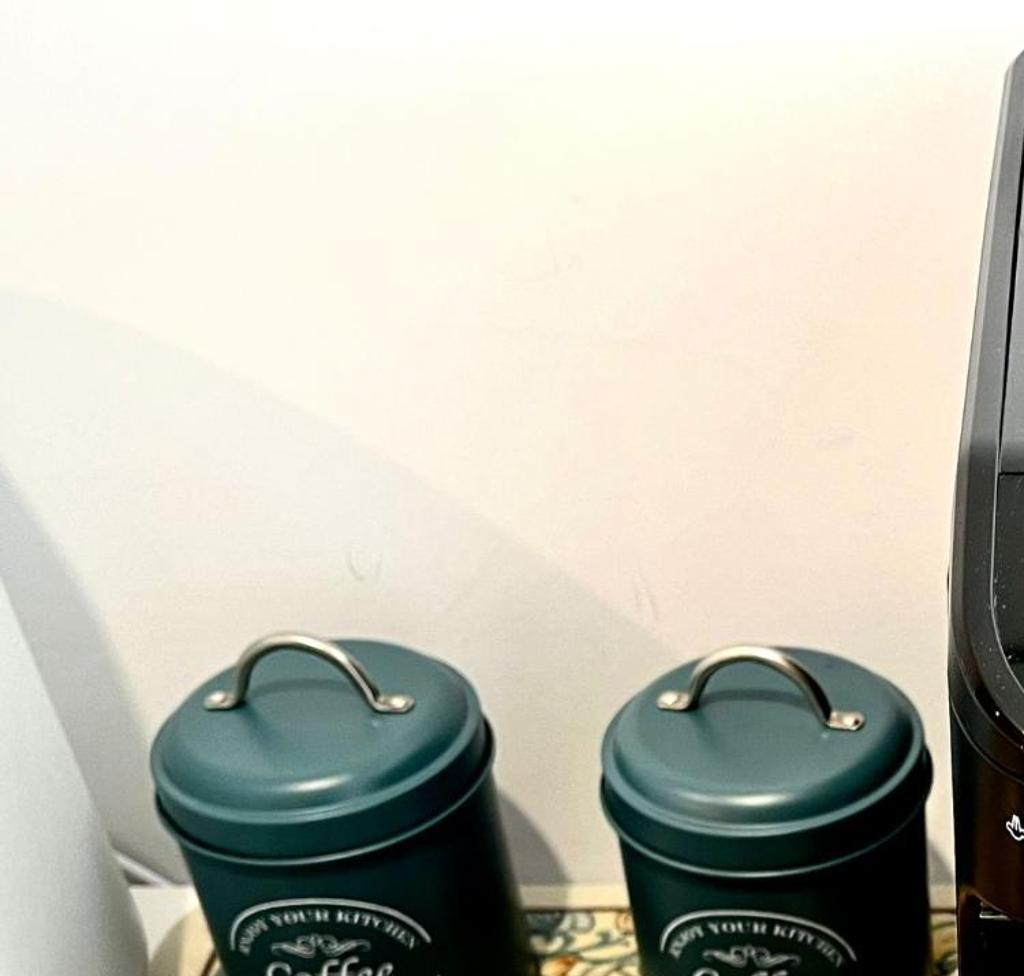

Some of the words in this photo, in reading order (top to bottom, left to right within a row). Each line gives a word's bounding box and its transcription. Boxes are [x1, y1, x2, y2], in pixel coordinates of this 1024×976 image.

[270, 907, 331, 928] YOUR
[335, 908, 416, 950] KITCHEN
[706, 920, 768, 935] YOUR
[772, 923, 844, 969] KITCHEN
